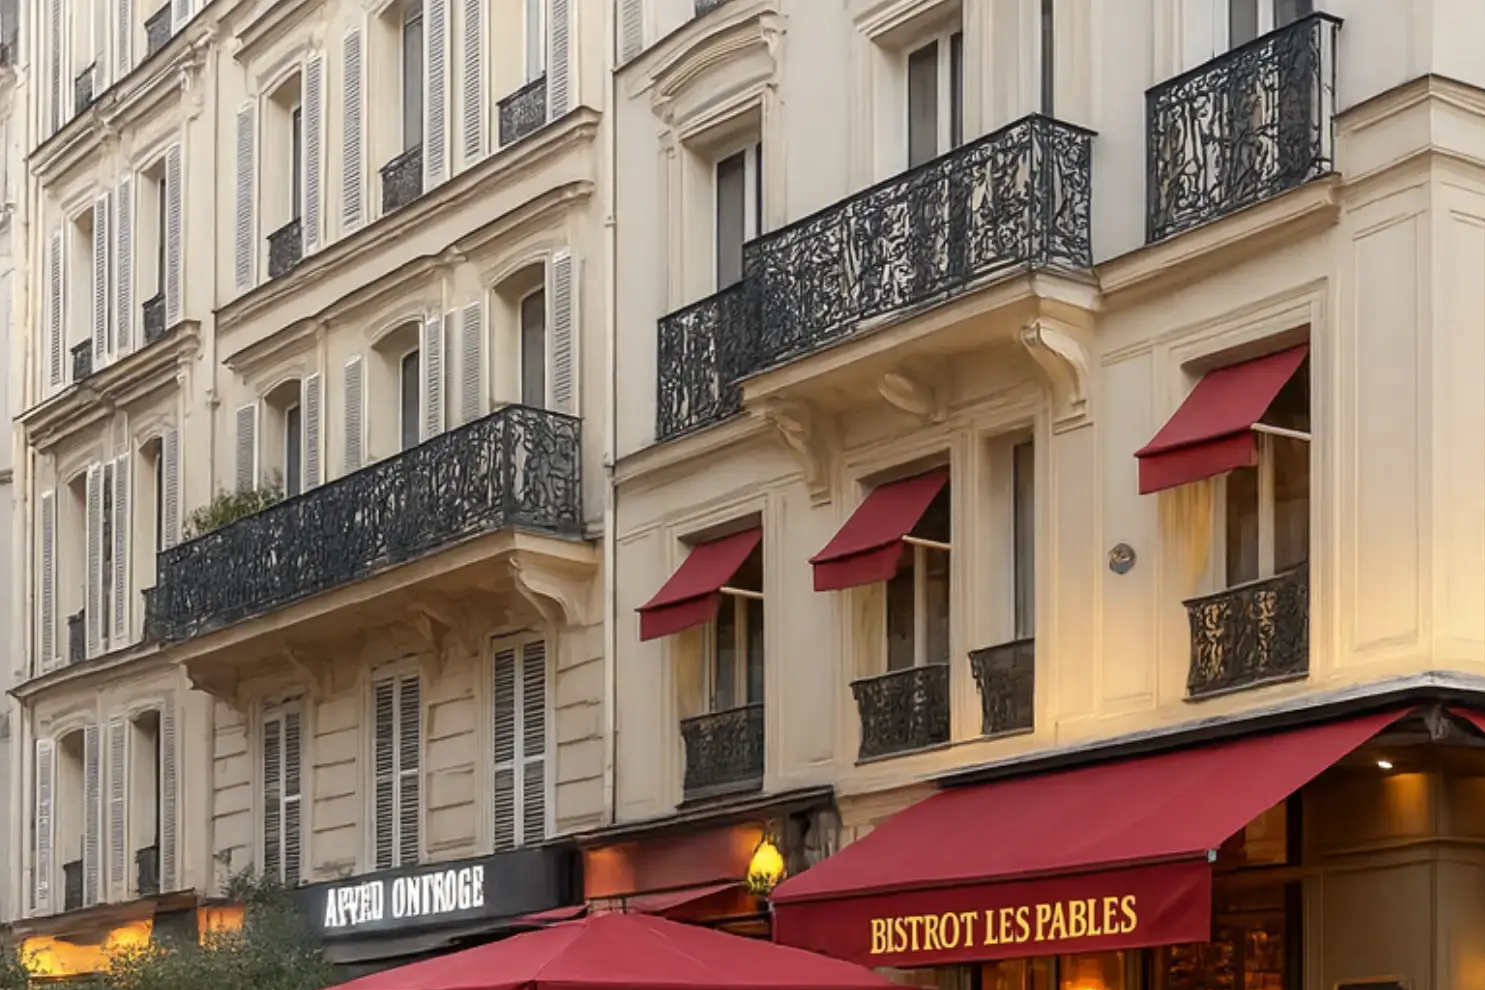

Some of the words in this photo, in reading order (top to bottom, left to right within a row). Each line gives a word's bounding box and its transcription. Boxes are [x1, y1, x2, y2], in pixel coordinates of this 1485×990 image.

[869, 912, 978, 954] BISTROT
[984, 906, 1030, 945] LES
[1034, 895, 1138, 941] PABLES
